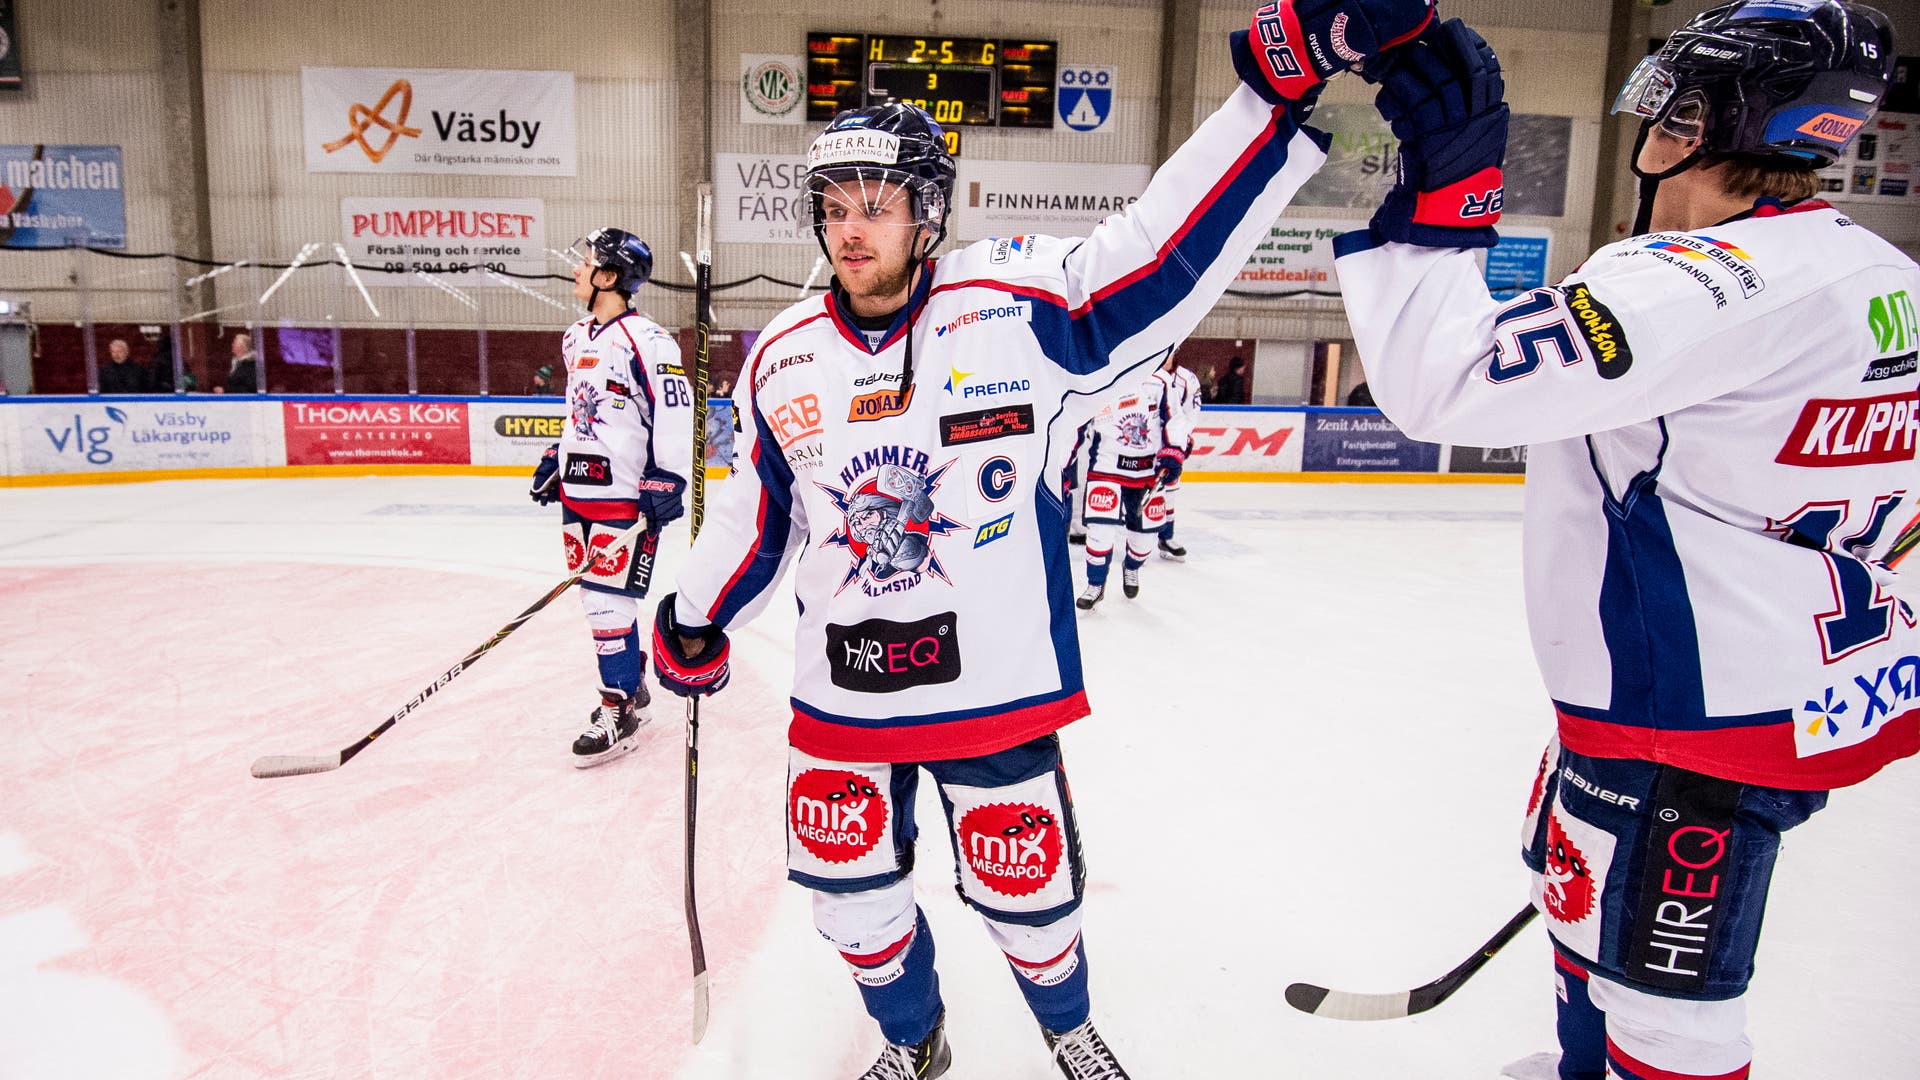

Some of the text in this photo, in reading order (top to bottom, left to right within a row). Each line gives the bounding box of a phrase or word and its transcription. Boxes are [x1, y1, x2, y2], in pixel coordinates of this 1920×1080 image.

[869, 39, 883, 61] H
[981, 44, 995, 65] G
[1308, 33, 1333, 71] HALMSTAD
[1860, 41, 1878, 60] 15
[927, 73, 938, 90] 3
[902, 99, 964, 124] :00
[431, 109, 541, 149] Väsby
[824, 137, 897, 151] HERRLIN
[414, 153, 432, 164] Där
[7, 155, 120, 190] matchen
[352, 210, 535, 238] PUMPHUSET
[1271, 228, 1312, 239] Hockey
[445, 245, 469, 255] och
[1277, 243, 1313, 253] energi
[1707, 248, 1758, 290] Bilaffär
[948, 306, 1024, 334] INTERSPORT
[1486, 288, 1583, 384] 15
[779, 353, 814, 370] BUSS
[663, 378, 690, 407] 88
[963, 379, 1030, 398] PRENAD
[155, 412, 207, 428] Väsby
[293, 402, 460, 424] THOMAS KÖK
[1316, 419, 1348, 431] Zenit
[45, 414, 113, 464] vlg
[132, 429, 232, 445] Läkargrupp
[342, 431, 433, 441] CATERING
[568, 462, 604, 479] HIREQ
[977, 455, 1017, 503] C
[976, 518, 1010, 544] ATG
[861, 573, 922, 597] HALMSTAD
[844, 637, 941, 673] HIREQ
[1564, 767, 1640, 811] BAUER
[797, 798, 869, 832] mix
[797, 825, 868, 846] MEGAPOL
[970, 828, 1046, 864] mix
[972, 858, 1046, 879] MEGAPOL
[1645, 825, 1731, 976] HIREQ
[862, 968, 901, 984] PRODUKT
